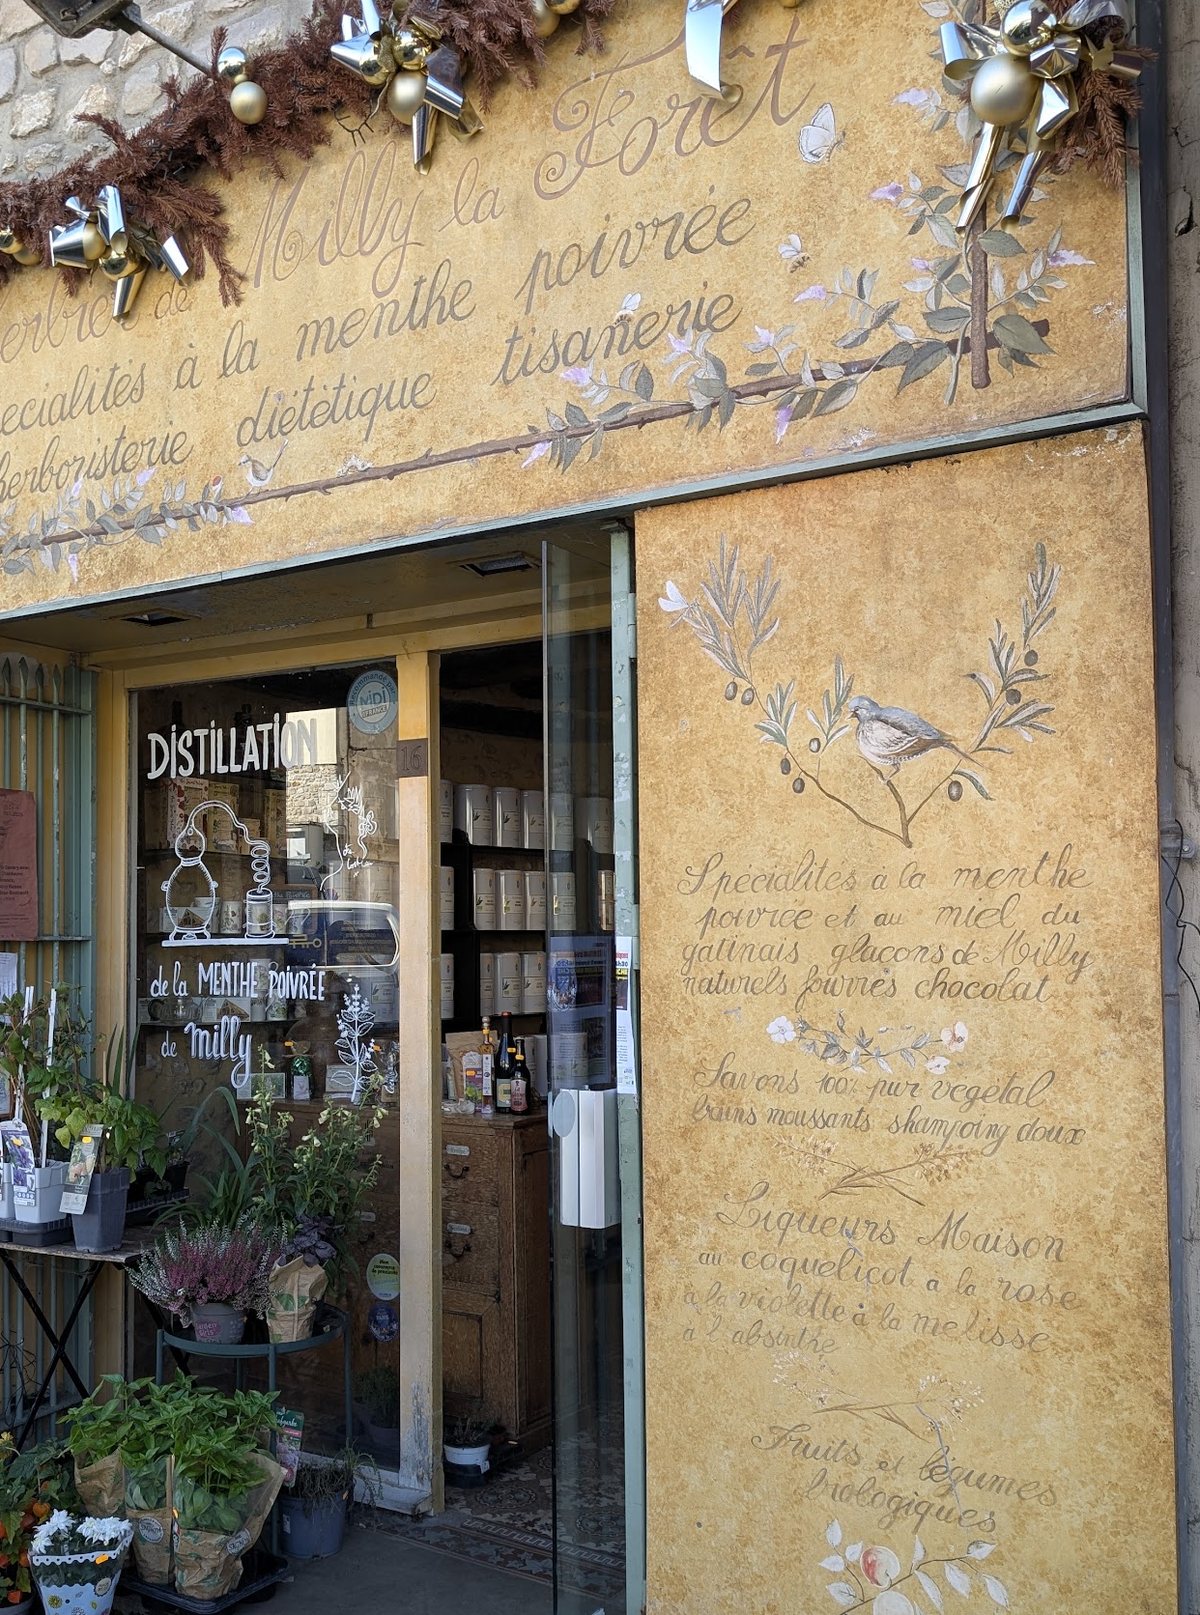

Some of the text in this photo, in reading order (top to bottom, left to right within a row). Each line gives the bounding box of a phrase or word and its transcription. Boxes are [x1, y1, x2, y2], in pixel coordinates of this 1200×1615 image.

[154, 280, 193, 320] de
[244, 140, 425, 299] Milly
[438, 157, 506, 232] la
[533, 13, 816, 201] Forêt
[217, 319, 261, 379] la
[296, 258, 477, 362] menthe
[514, 184, 757, 316] poivrée
[236, 373, 438, 448] diététique
[490, 281, 744, 386] tisanerie
[401, 745, 422, 771] 16
[898, 861, 927, 890] la
[953, 843, 1094, 890] menthe
[824, 904, 856, 928] et
[874, 912, 903, 927] au
[935, 893, 1022, 929] miel
[1041, 903, 1080, 925] du
[150, 965, 170, 998] de
[173, 961, 189, 997] la
[198, 961, 258, 999] MENTHE
[952, 940, 980, 965] de
[982, 929, 1094, 985] Milly
[683, 966, 787, 997] naturels
[915, 967, 1053, 1003] chocolat
[161, 1030, 178, 1058] de
[693, 1052, 799, 1094] Savons
[866, 1077, 921, 1103] pur
[692, 1093, 757, 1127] bains
[766, 1106, 871, 1132] moussants
[1016, 1117, 1086, 1145] doux
[716, 1181, 1064, 1262] Liqueurs Maison
[698, 1252, 723, 1265] au
[741, 1248, 914, 1290] coquelicot
[955, 1266, 977, 1297] la
[998, 1276, 1083, 1310] rose
[706, 1281, 727, 1308] la
[738, 1283, 849, 1323] violette
[879, 1303, 901, 1331] la
[751, 1423, 861, 1466] Fruits
[805, 1467, 997, 1535] biologiques
